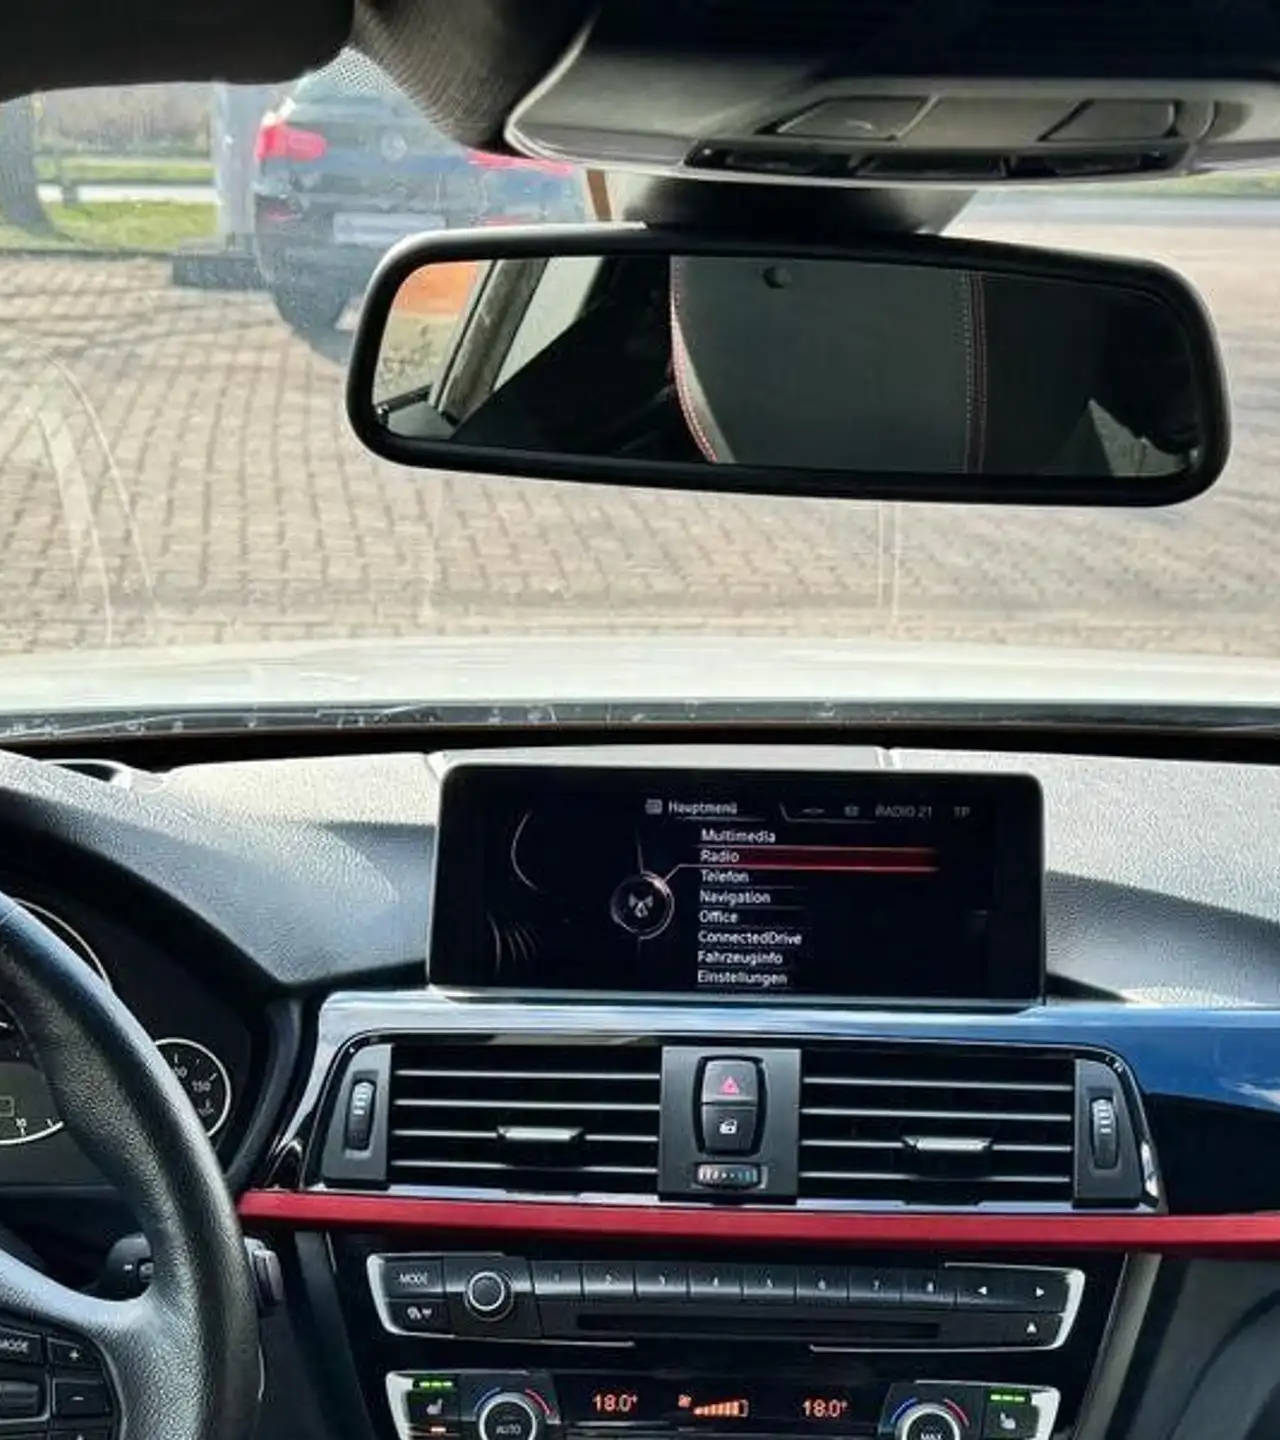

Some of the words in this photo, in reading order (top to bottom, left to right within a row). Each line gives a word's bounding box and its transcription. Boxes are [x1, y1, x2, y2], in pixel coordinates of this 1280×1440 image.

[700, 829, 776, 843] Multimedia
[700, 849, 740, 863] Radio
[701, 869, 749, 883] Telefon
[700, 889, 771, 907] Navigation
[699, 909, 738, 923] Office
[698, 929, 802, 945] ConnectedDrive
[698, 950, 783, 966] Fahrzeuginfo
[698, 969, 788, 987] Einstellungen
